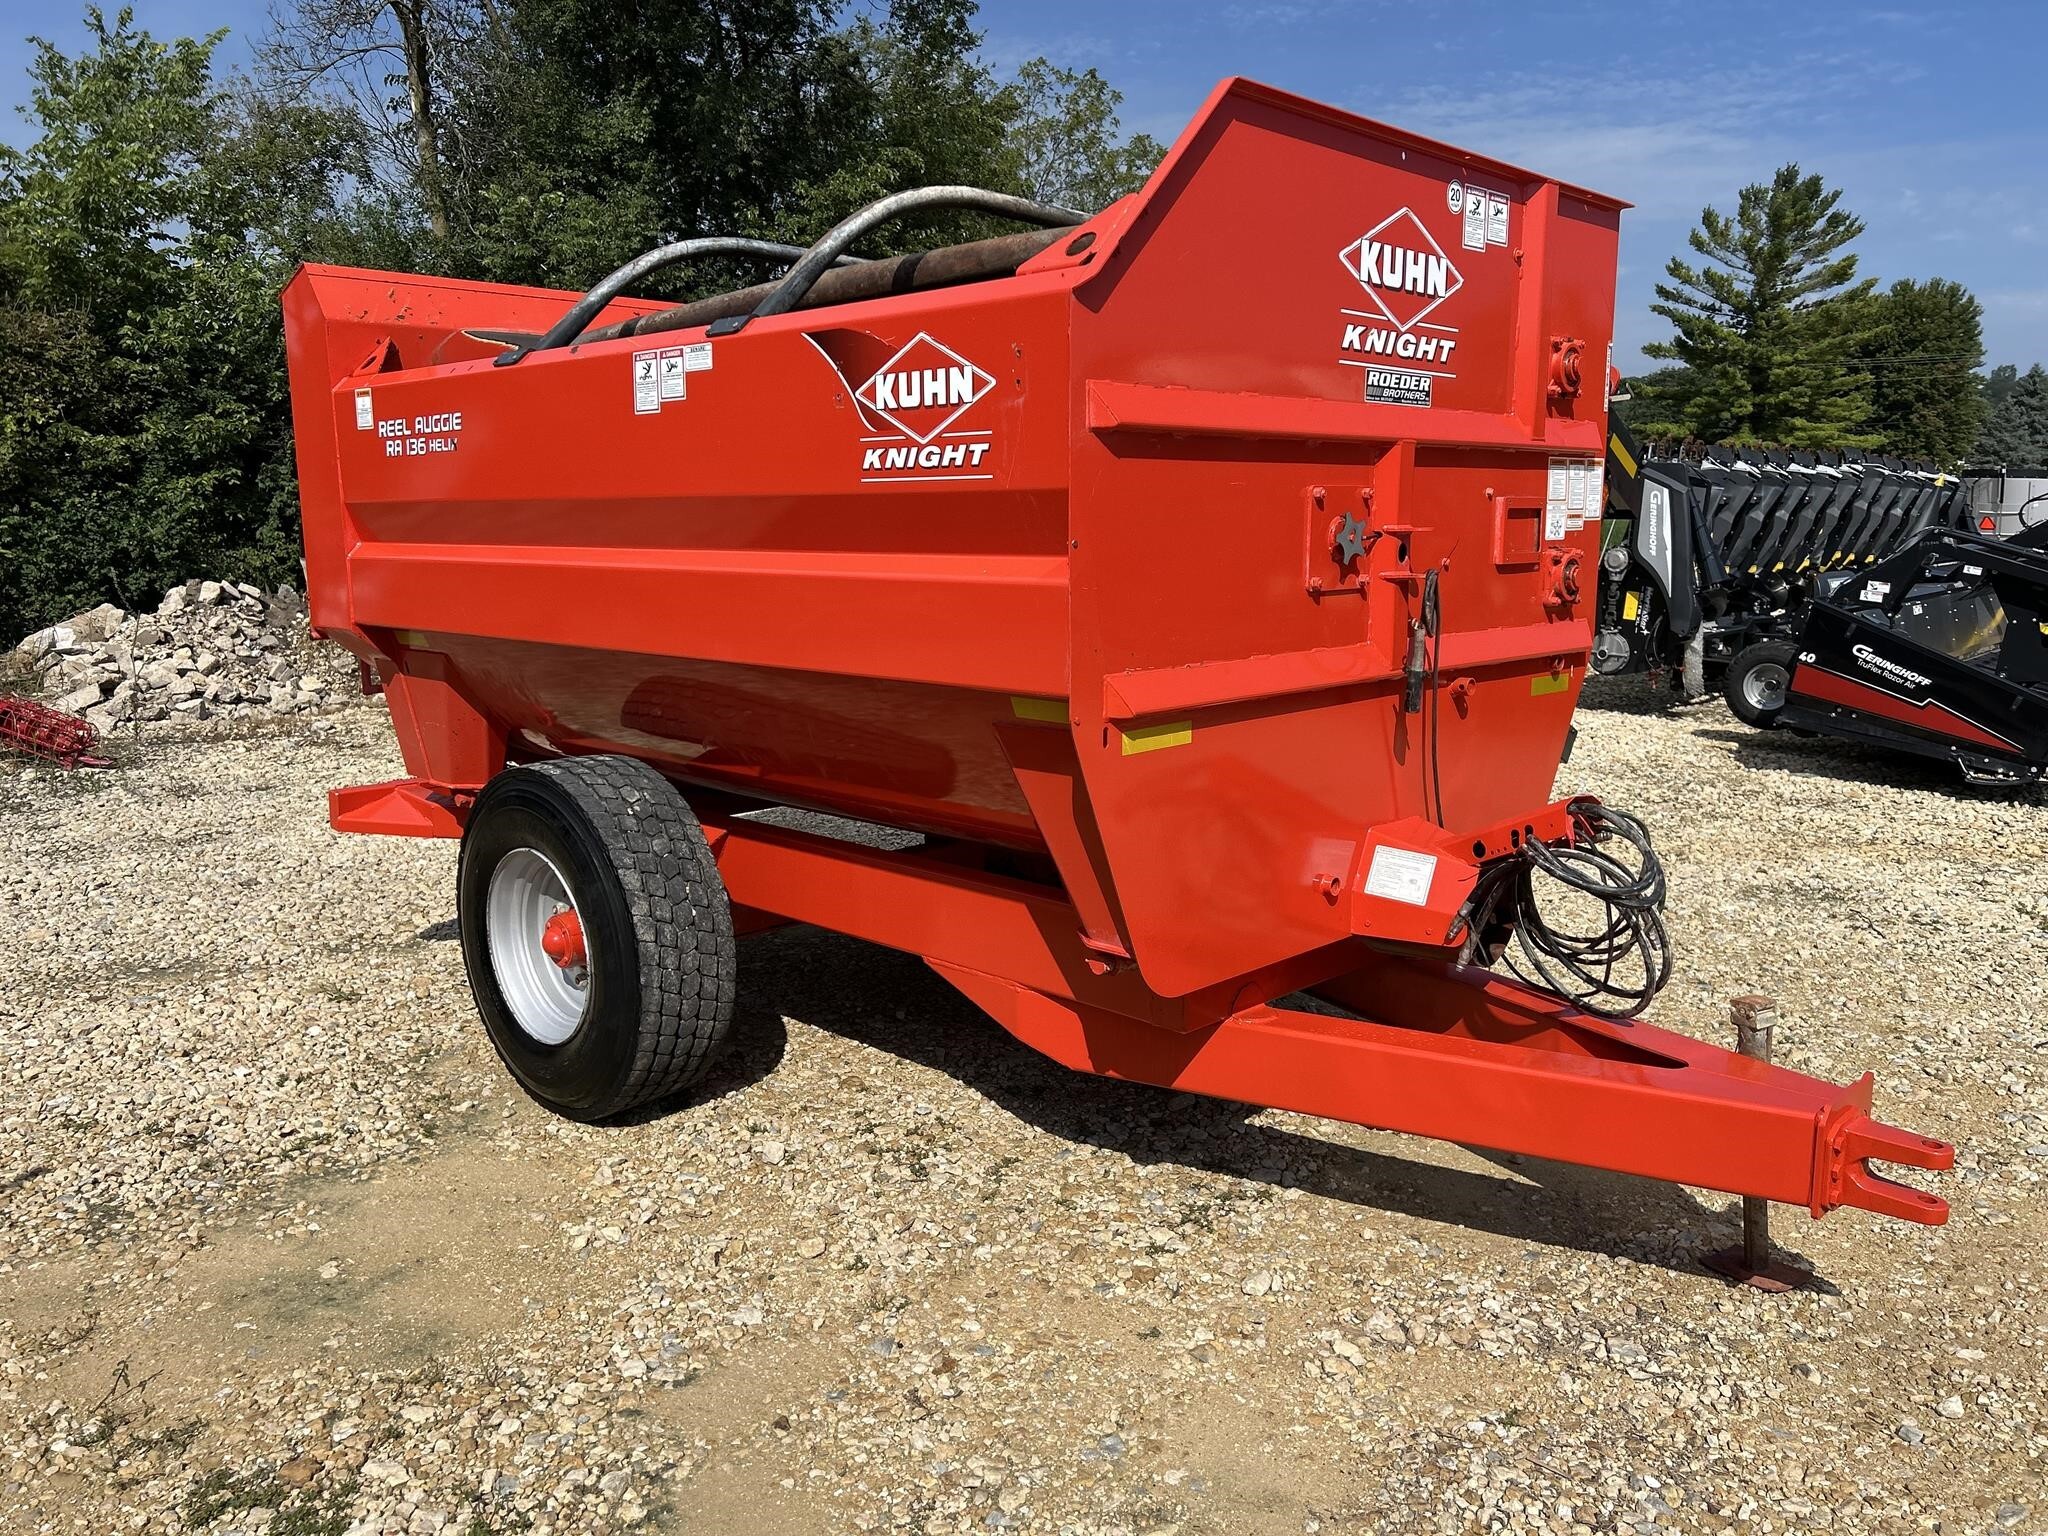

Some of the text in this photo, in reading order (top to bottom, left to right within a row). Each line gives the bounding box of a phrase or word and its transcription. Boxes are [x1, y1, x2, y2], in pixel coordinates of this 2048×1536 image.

[1451, 188, 1460, 202] 20
[1359, 238, 1448, 298] KUHN
[1341, 324, 1456, 364] KNIGHT
[875, 365, 973, 410] KUHN
[1368, 371, 1430, 391] ROEDER
[1383, 388, 1426, 400] BROTHERS
[378, 412, 462, 437] REEL AUGGIE
[386, 440, 402, 456] RA
[406, 438, 427, 456] 136
[862, 443, 990, 470] KNIGHT
[1649, 491, 1661, 556] GERINGHOFF
[1798, 652, 1816, 663] 40
[1852, 644, 1933, 686] GERINGHOFF
[1857, 658, 1916, 689] TruFlex Razor Air
